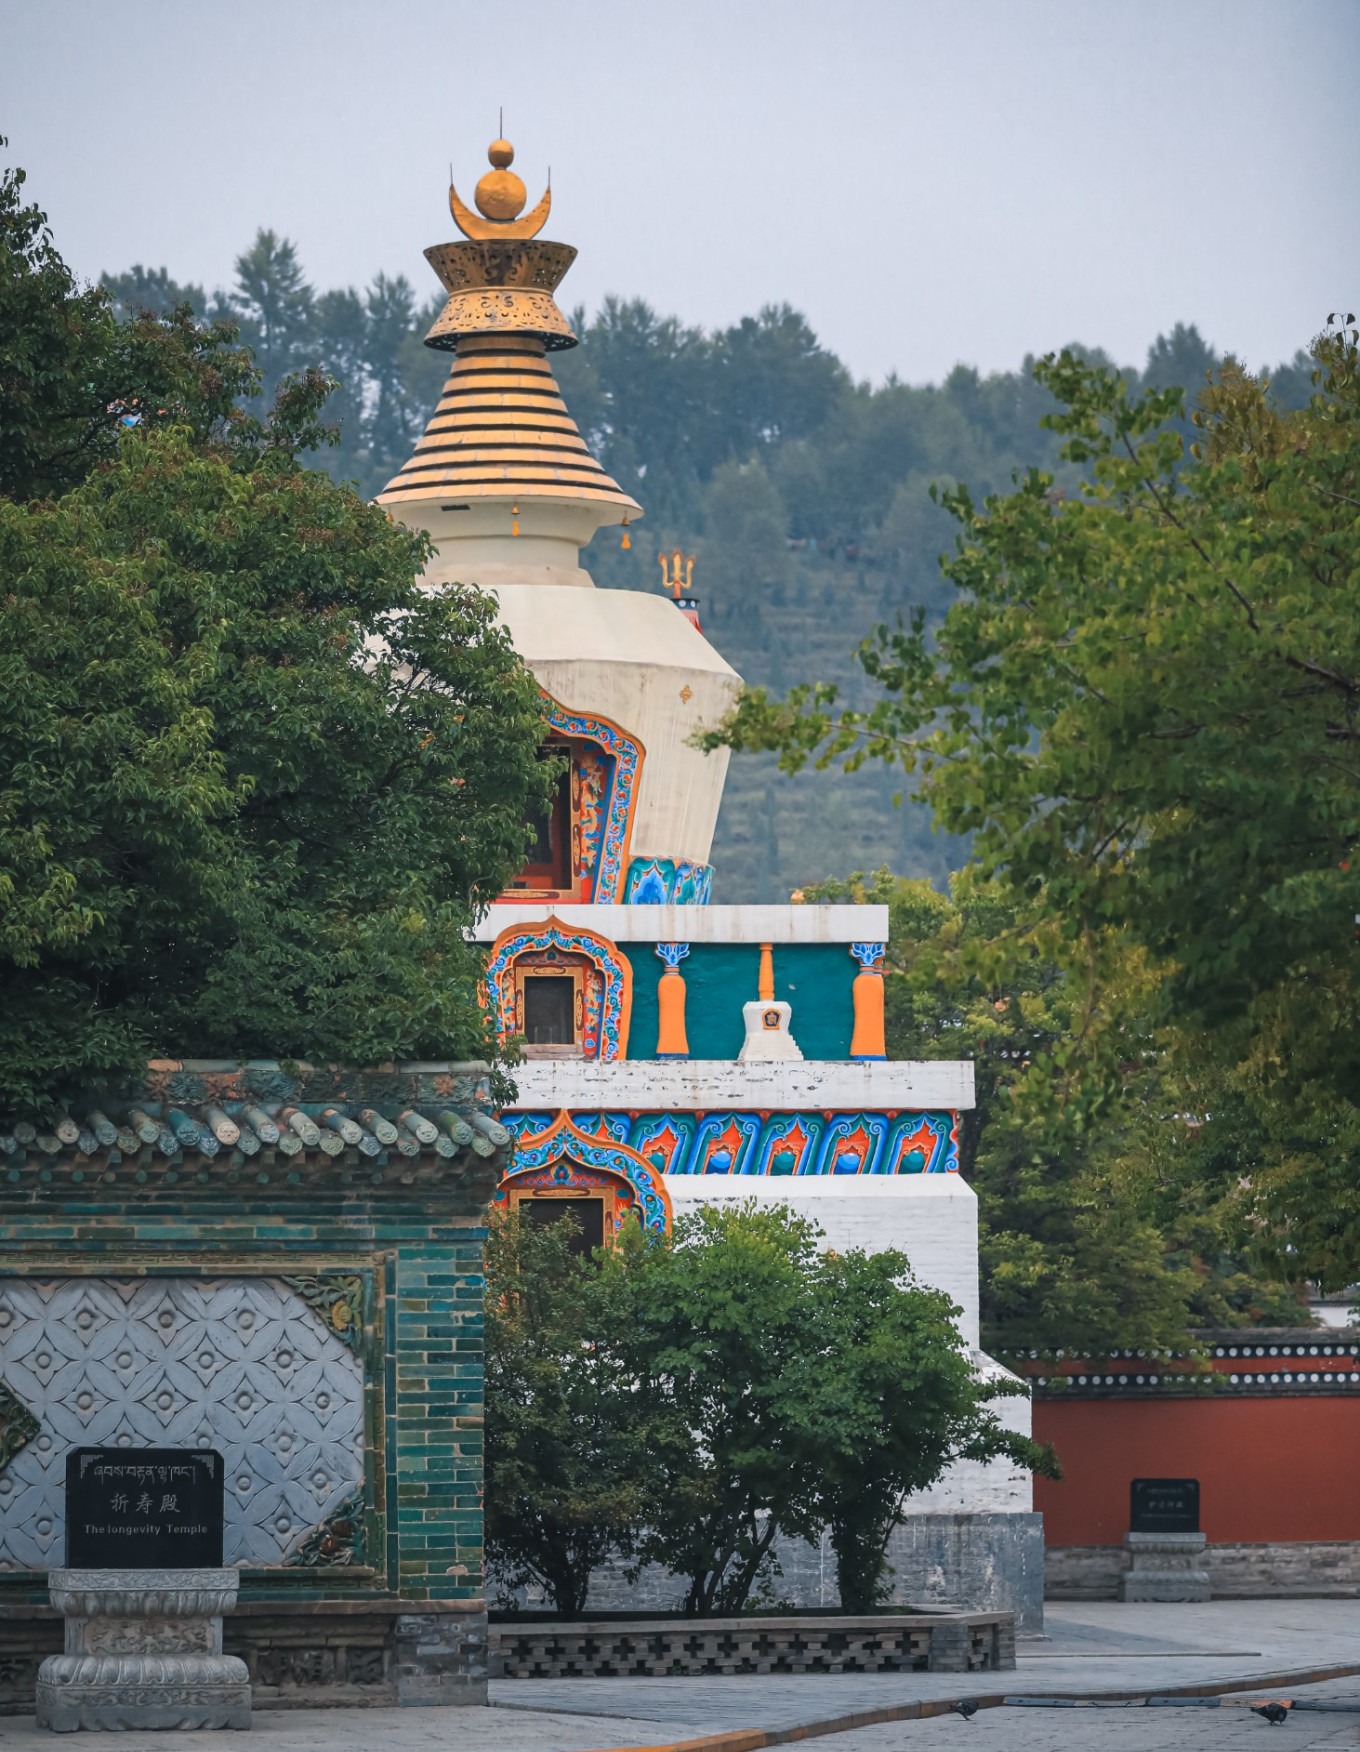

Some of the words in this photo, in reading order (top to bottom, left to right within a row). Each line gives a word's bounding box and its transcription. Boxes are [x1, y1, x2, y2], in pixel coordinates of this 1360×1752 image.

[110, 1492, 181, 1515] 祈寿殿
[85, 1524, 105, 1534] The
[108, 1524, 160, 1535] longevity
[166, 1524, 208, 1535] Temple
